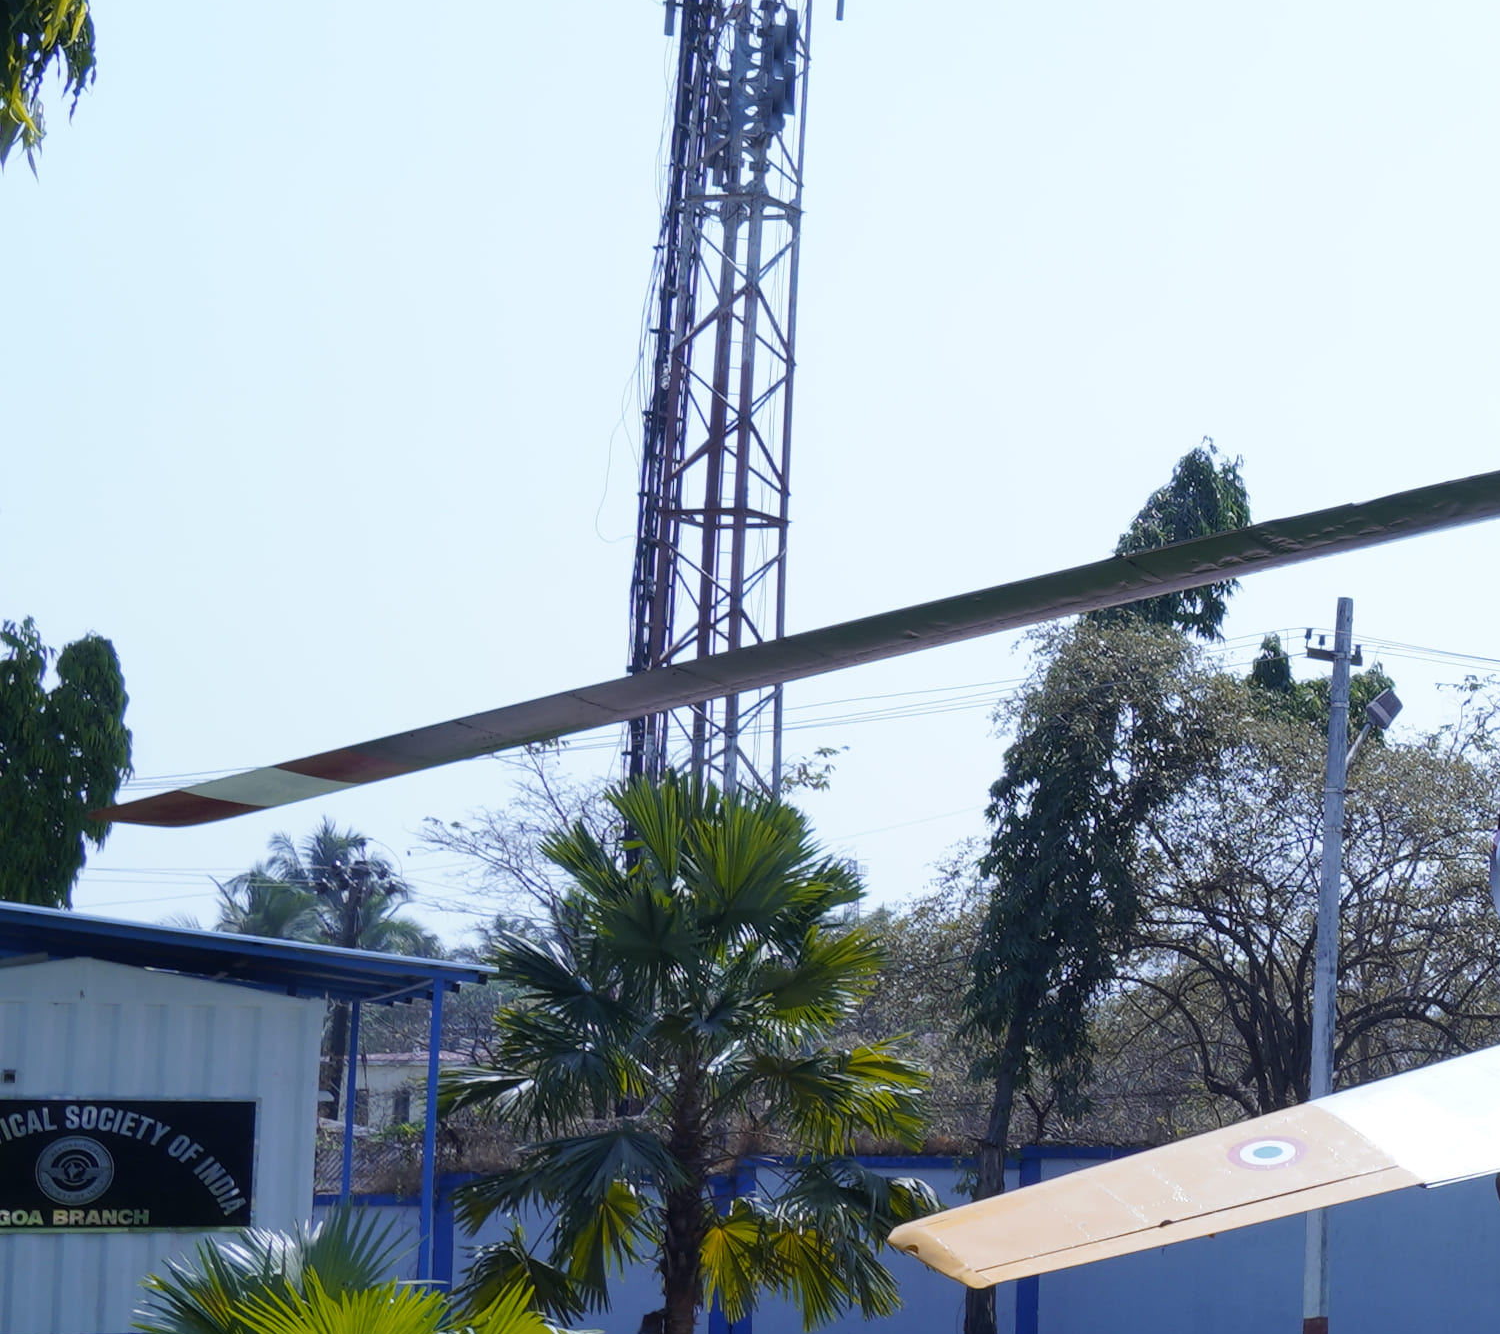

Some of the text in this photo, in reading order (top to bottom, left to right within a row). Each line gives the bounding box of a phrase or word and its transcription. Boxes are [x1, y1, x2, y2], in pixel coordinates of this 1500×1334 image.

[0, 1105, 247, 1216] ICAL SOCIETY OF INDIA
[0, 1209, 150, 1226] GOA BRANCH
